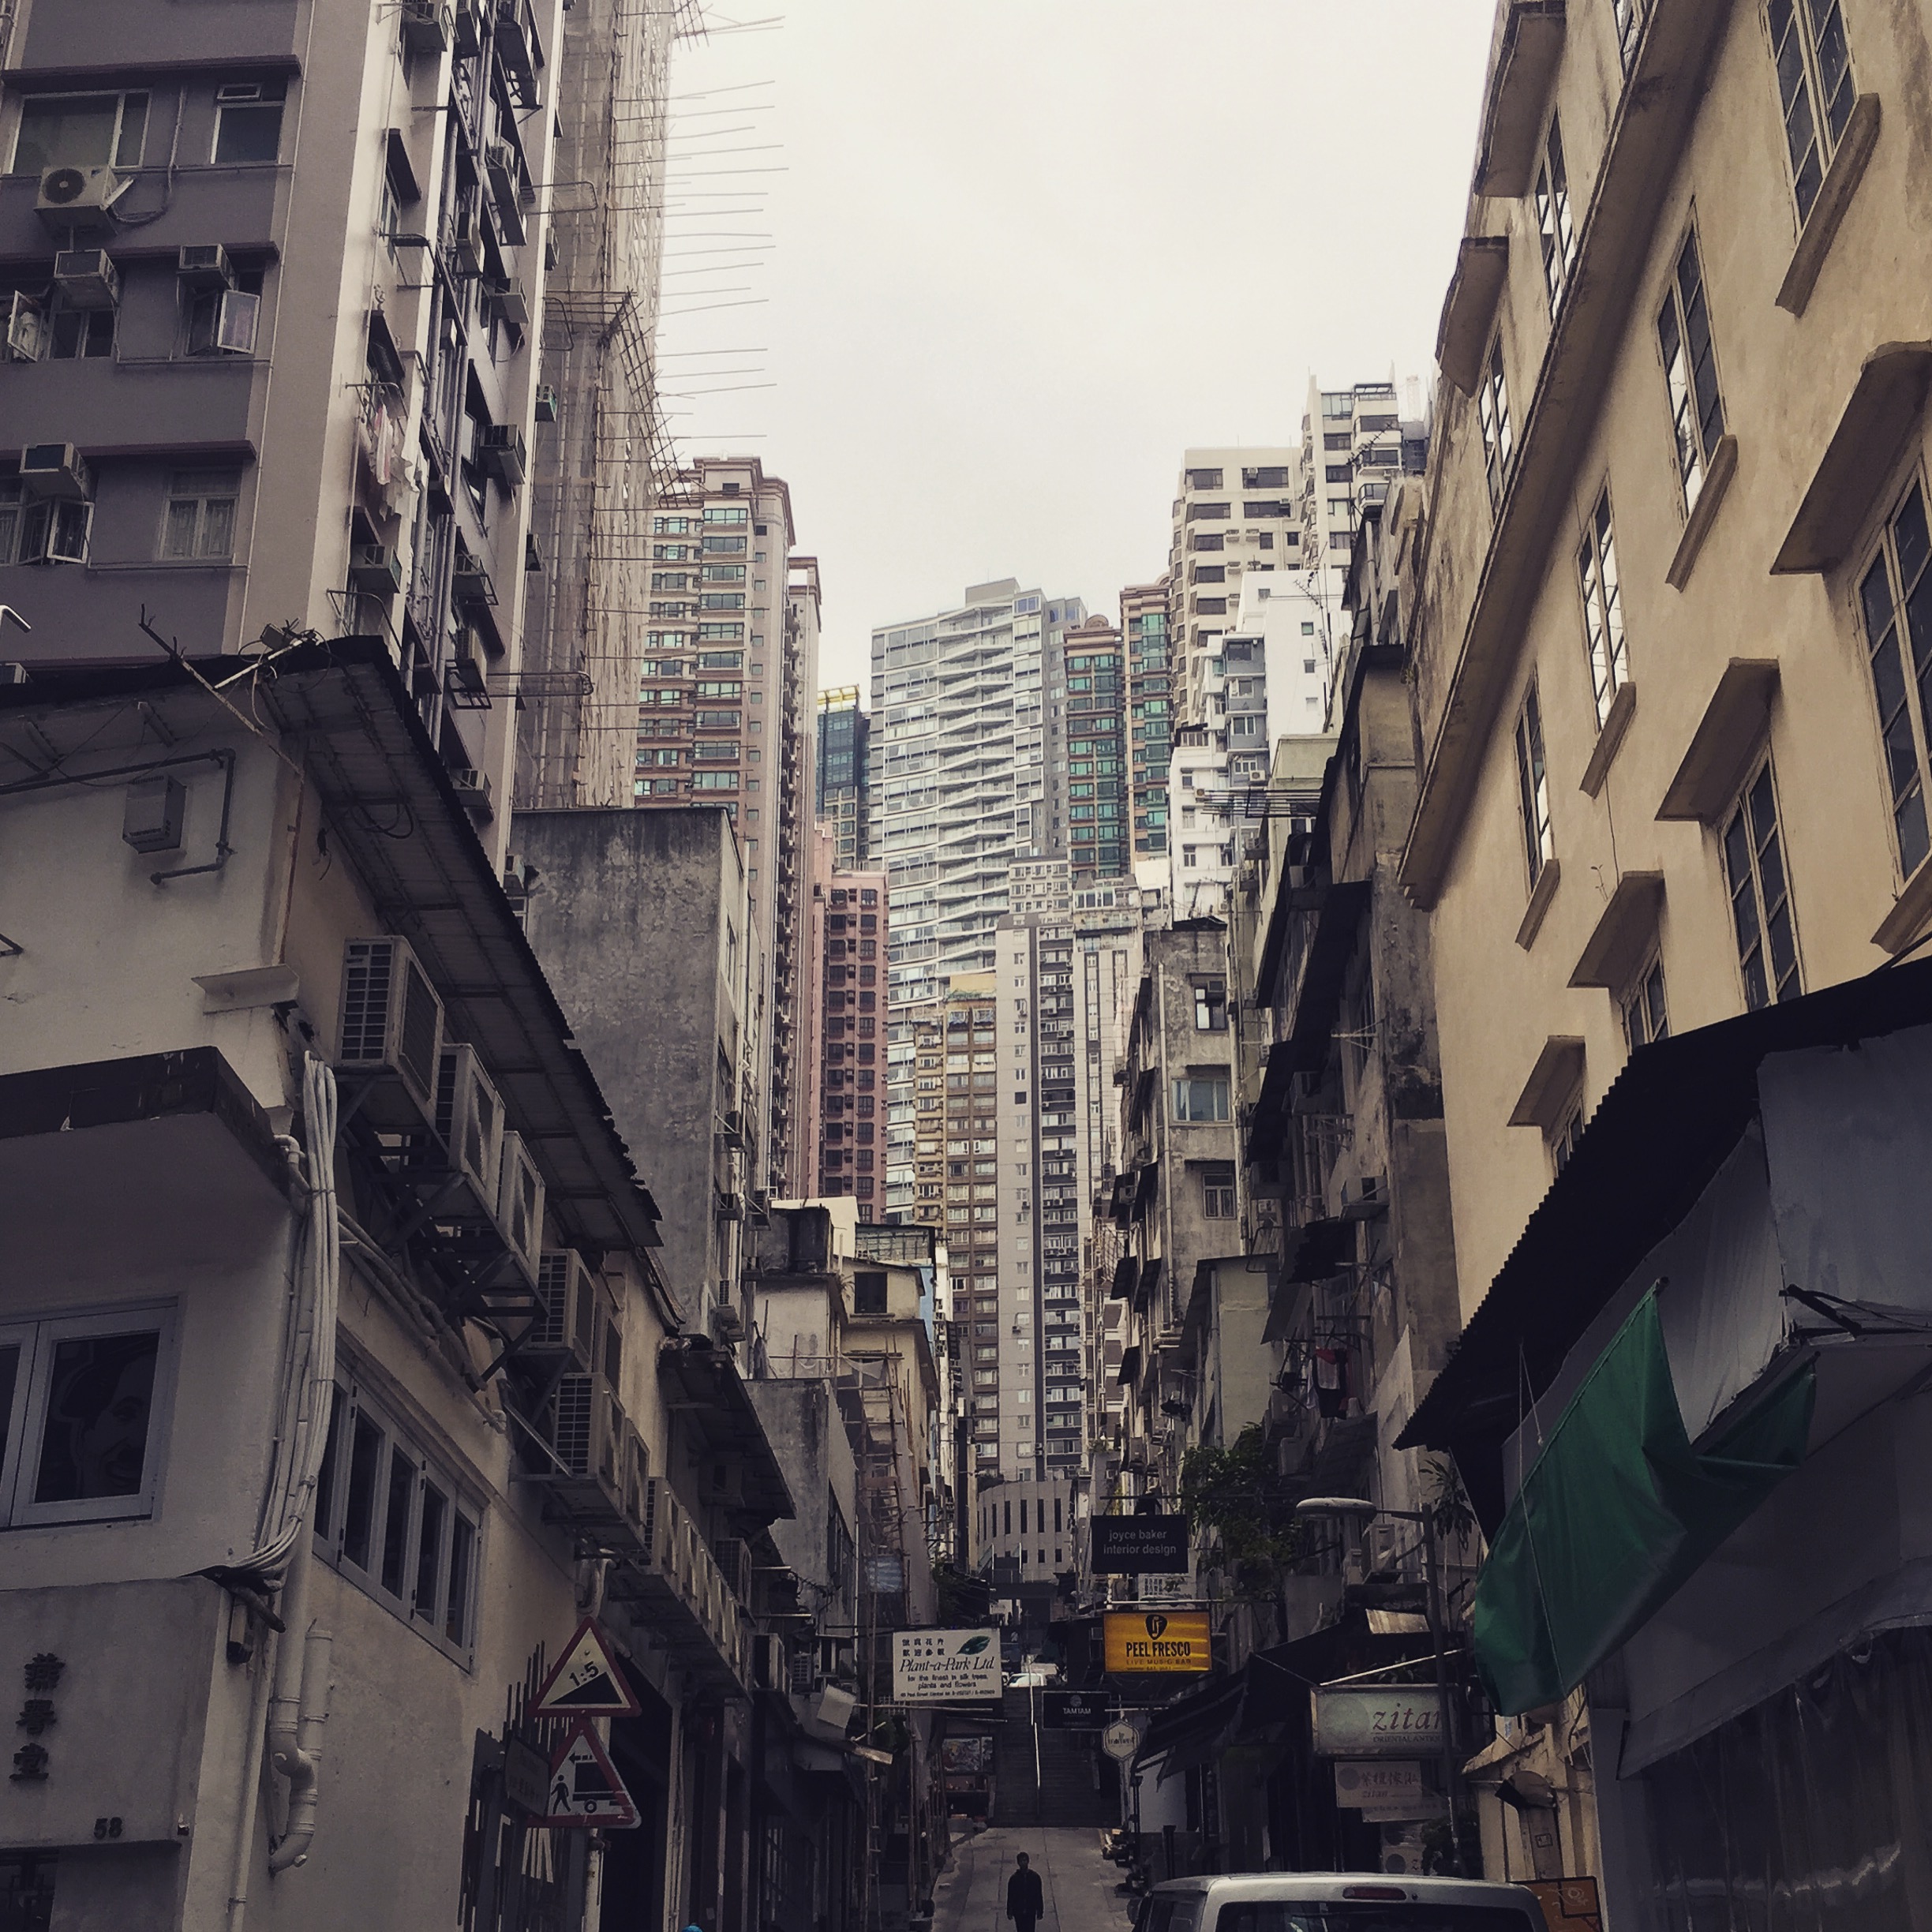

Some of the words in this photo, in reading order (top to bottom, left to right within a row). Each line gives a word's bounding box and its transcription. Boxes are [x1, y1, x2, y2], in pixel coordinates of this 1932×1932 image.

[1108, 1529, 1136, 1542] joyce
[1139, 1529, 1167, 1539] baker
[1103, 1544, 1140, 1554] interior
[1142, 1544, 1177, 1556] design
[1126, 1642, 1151, 1657] PEEL
[1152, 1641, 1191, 1657] FRESCO
[569, 1661, 600, 1687] 1:5
[93, 1816, 123, 1840] 58
